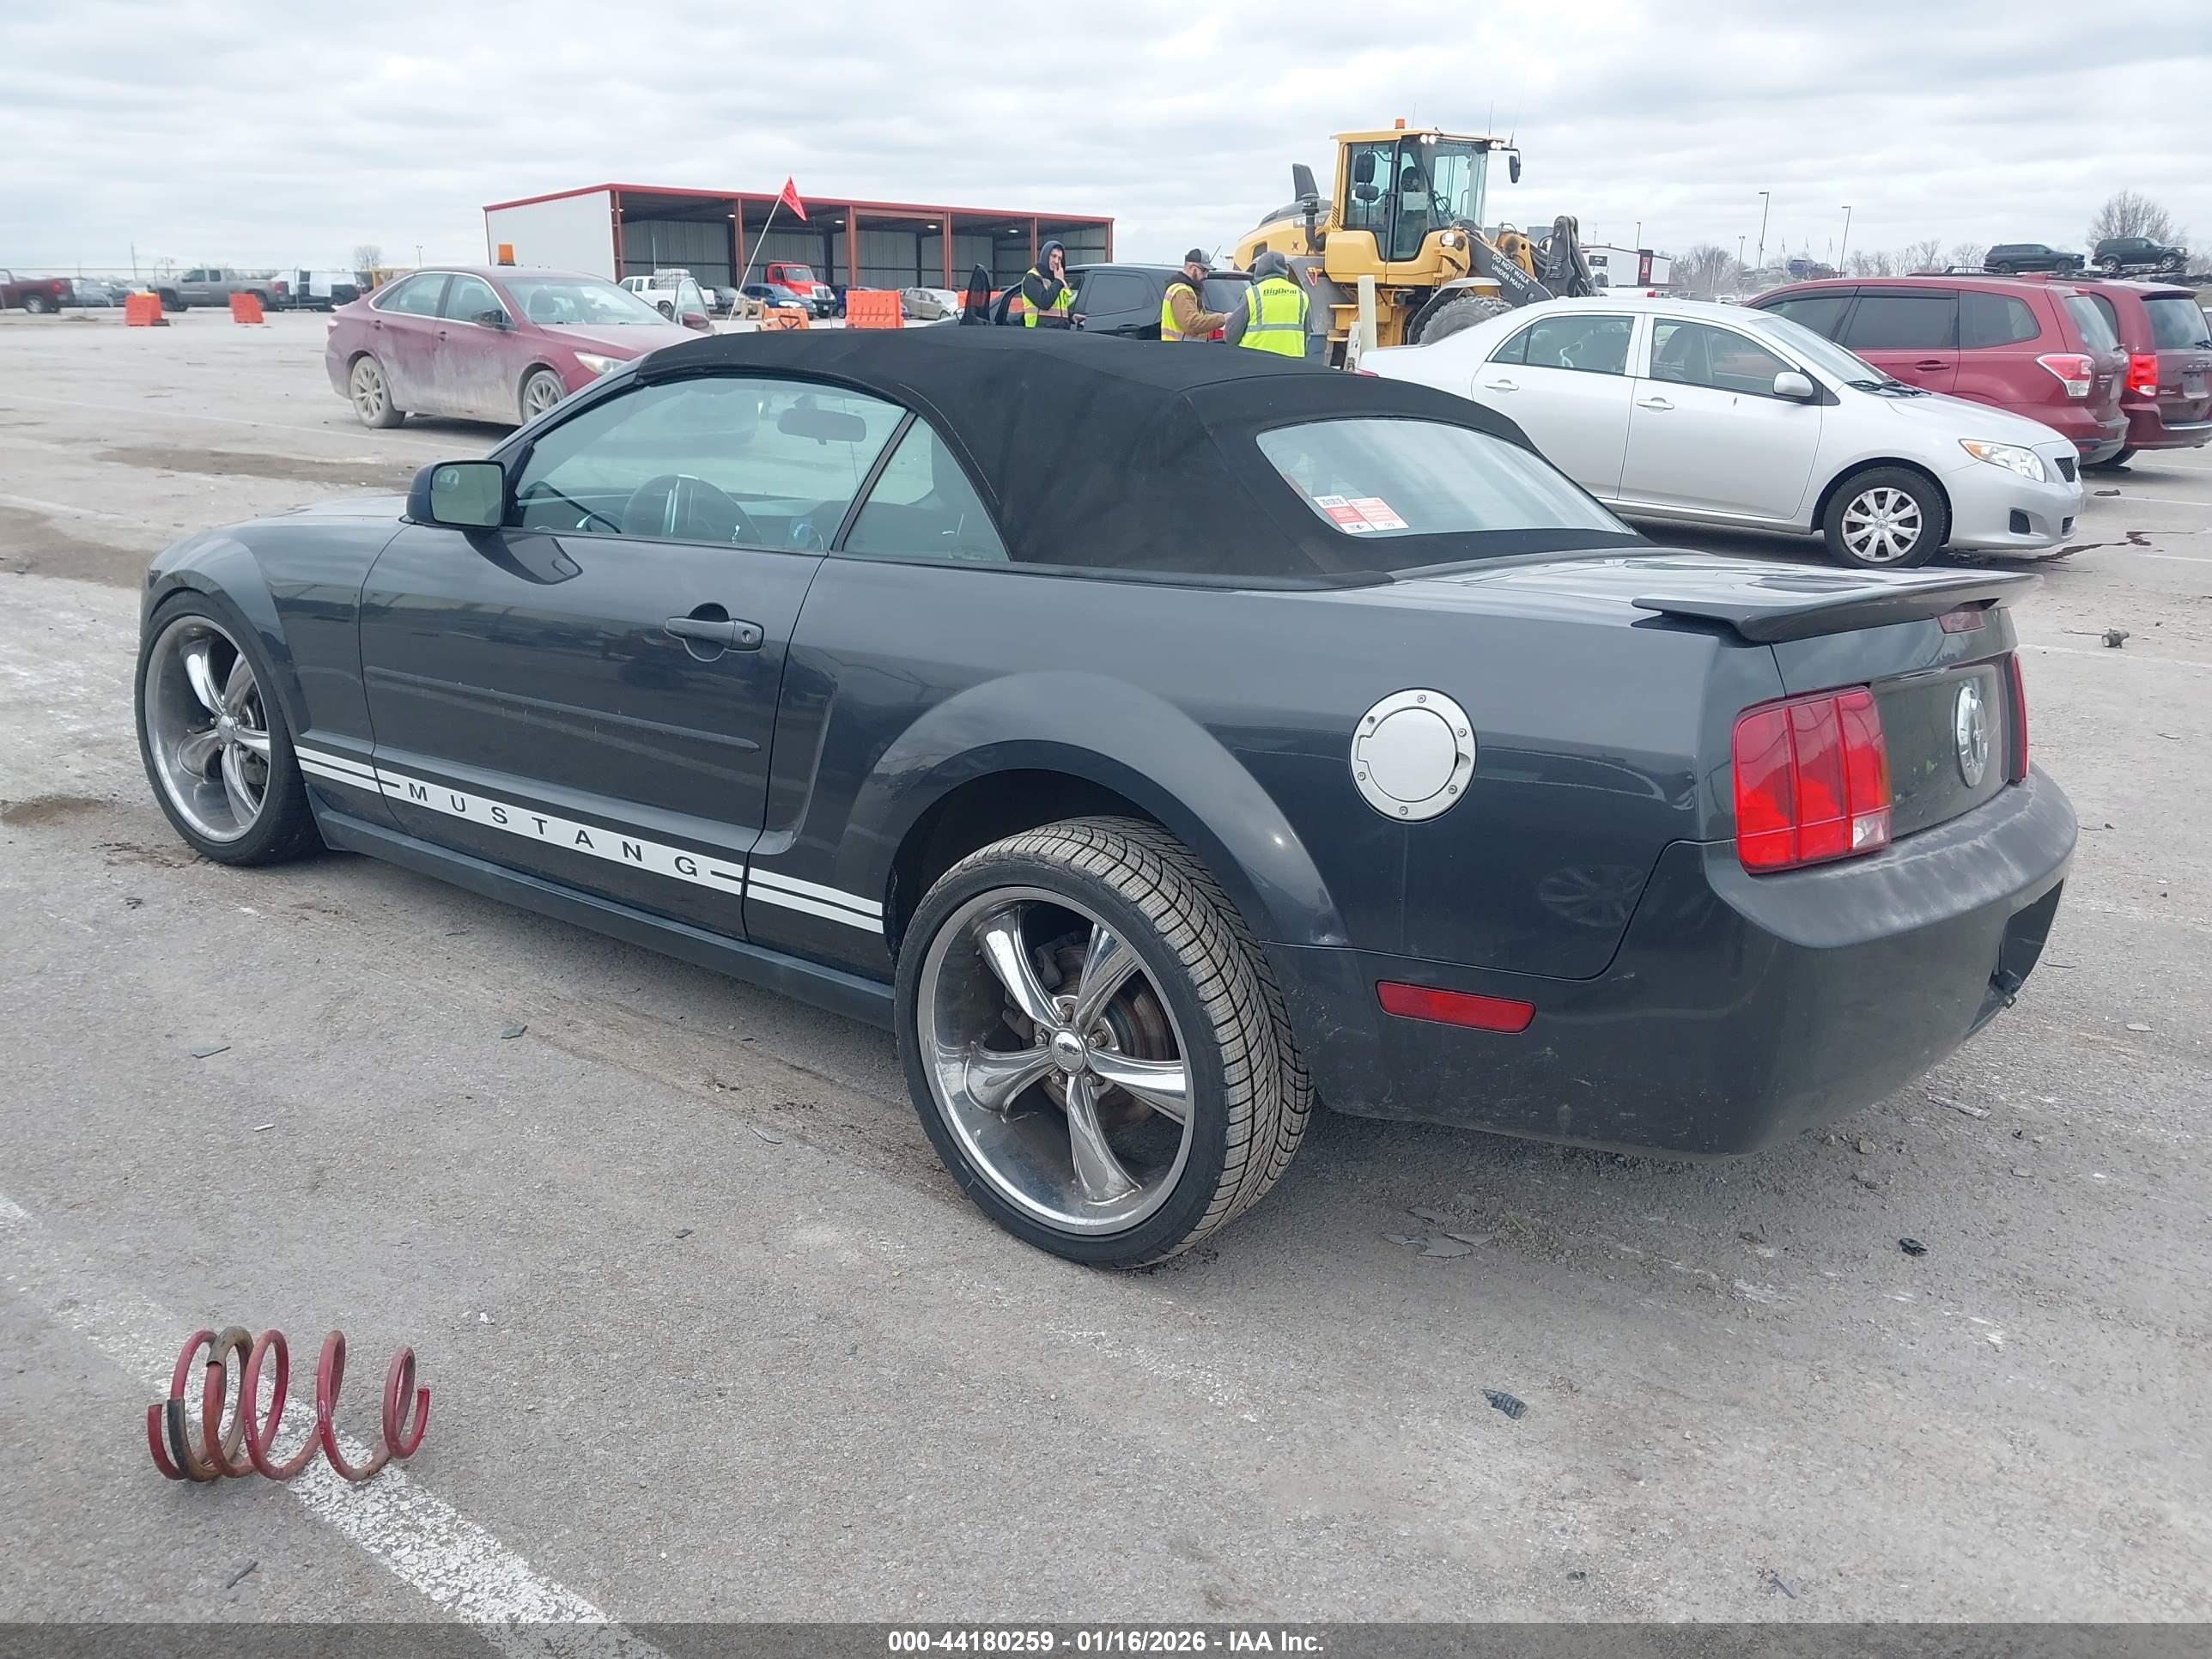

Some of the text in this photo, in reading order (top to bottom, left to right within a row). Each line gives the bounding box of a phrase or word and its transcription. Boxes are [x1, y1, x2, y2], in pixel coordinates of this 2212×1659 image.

[1492, 253, 1530, 285] DO NOT WALK
[1492, 263, 1525, 290] UNDER MAST
[408, 782, 698, 877] MUSTANG
